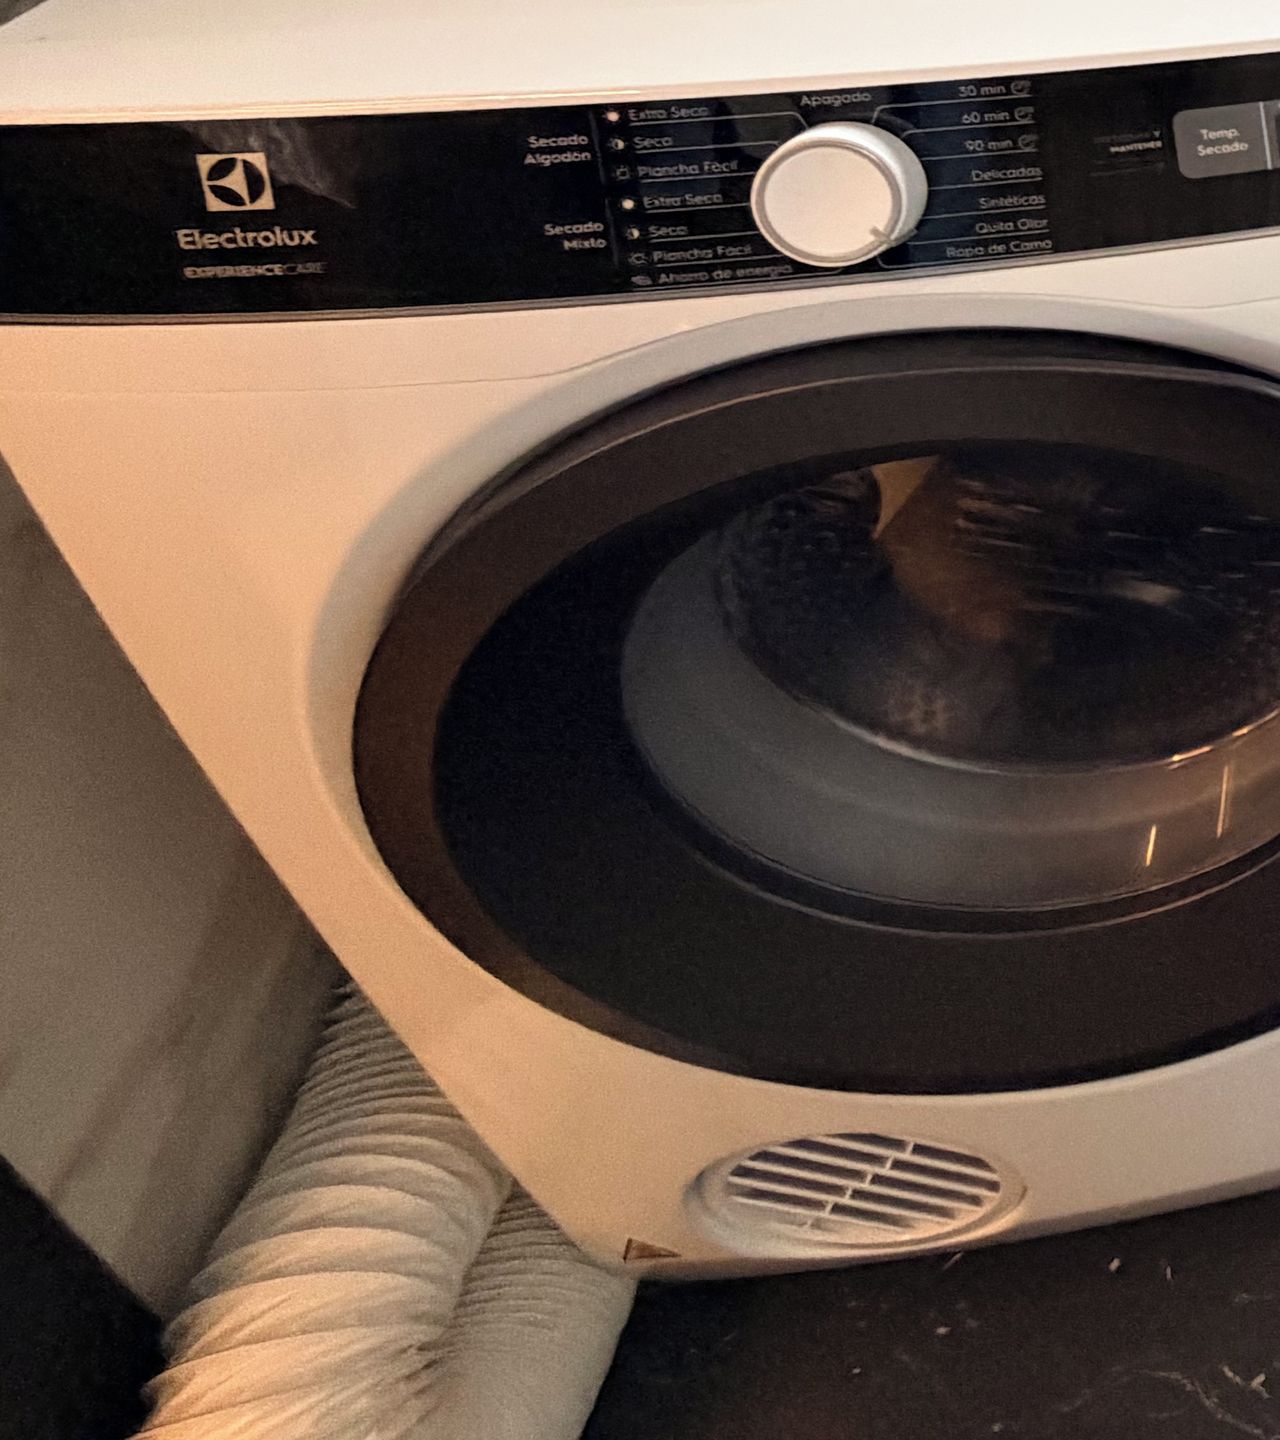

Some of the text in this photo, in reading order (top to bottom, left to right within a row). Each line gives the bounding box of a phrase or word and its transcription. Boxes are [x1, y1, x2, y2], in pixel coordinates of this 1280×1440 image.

[958, 83, 1006, 97] 30 min
[800, 91, 872, 108] Apagado
[962, 110, 1009, 124] 60 min
[528, 134, 588, 148] Secado
[634, 136, 673, 147] Seco
[1200, 128, 1240, 141] Temp.
[965, 138, 1013, 152] 90 min
[1197, 142, 1249, 157] Secado
[524, 150, 591, 166] Algodón
[637, 162, 699, 178] Plancha
[643, 192, 723, 208] Extra Seco
[544, 221, 604, 235] Secado
[649, 225, 689, 237] Seco
[975, 220, 1016, 234] Quita
[176, 225, 318, 250] Electrolux
[563, 237, 607, 250] Mixto
[653, 247, 713, 263] Plancha
[946, 239, 1053, 259] Ropa de Cama
